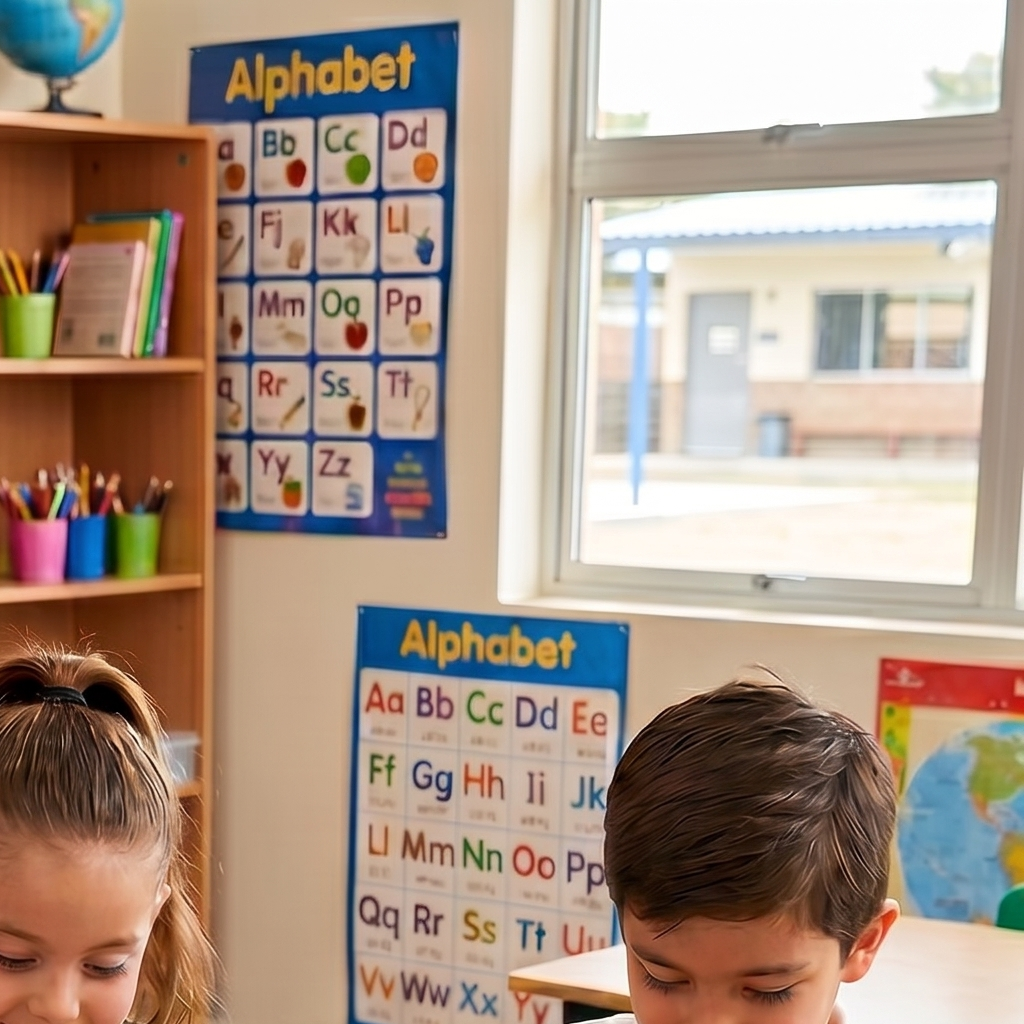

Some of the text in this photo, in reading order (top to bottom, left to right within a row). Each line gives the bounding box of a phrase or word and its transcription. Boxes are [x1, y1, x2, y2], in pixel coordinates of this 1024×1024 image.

[225, 41, 416, 114] Alphabet
[262, 129, 296, 157] Bb
[324, 125, 360, 153] Cc
[387, 116, 428, 151] Dd
[323, 206, 359, 237] Kk
[258, 290, 306, 318] Mm
[386, 288, 423, 326] Pp
[258, 369, 289, 397] Rr
[321, 370, 351, 397] Ss
[385, 369, 414, 398] Tt
[258, 449, 291, 485] Yy
[318, 450, 352, 478] Zz
[399, 618, 577, 670] Alphabet
[365, 681, 608, 737] Aa Bb Cc Dd Ee
[369, 753, 606, 811] Ff Gg Hh Ii Jk
[401, 829, 455, 868] Mm
[462, 837, 503, 874] Nn
[512, 844, 556, 881] Oo
[566, 850, 605, 895] Pp
[359, 895, 400, 940] Qq
[413, 904, 444, 937] Rr
[462, 908, 497, 944] Ss
[516, 918, 546, 952] Tt
[360, 964, 395, 1000] Vv
[400, 969, 450, 1009] Ww
[458, 980, 498, 1017] Xx
